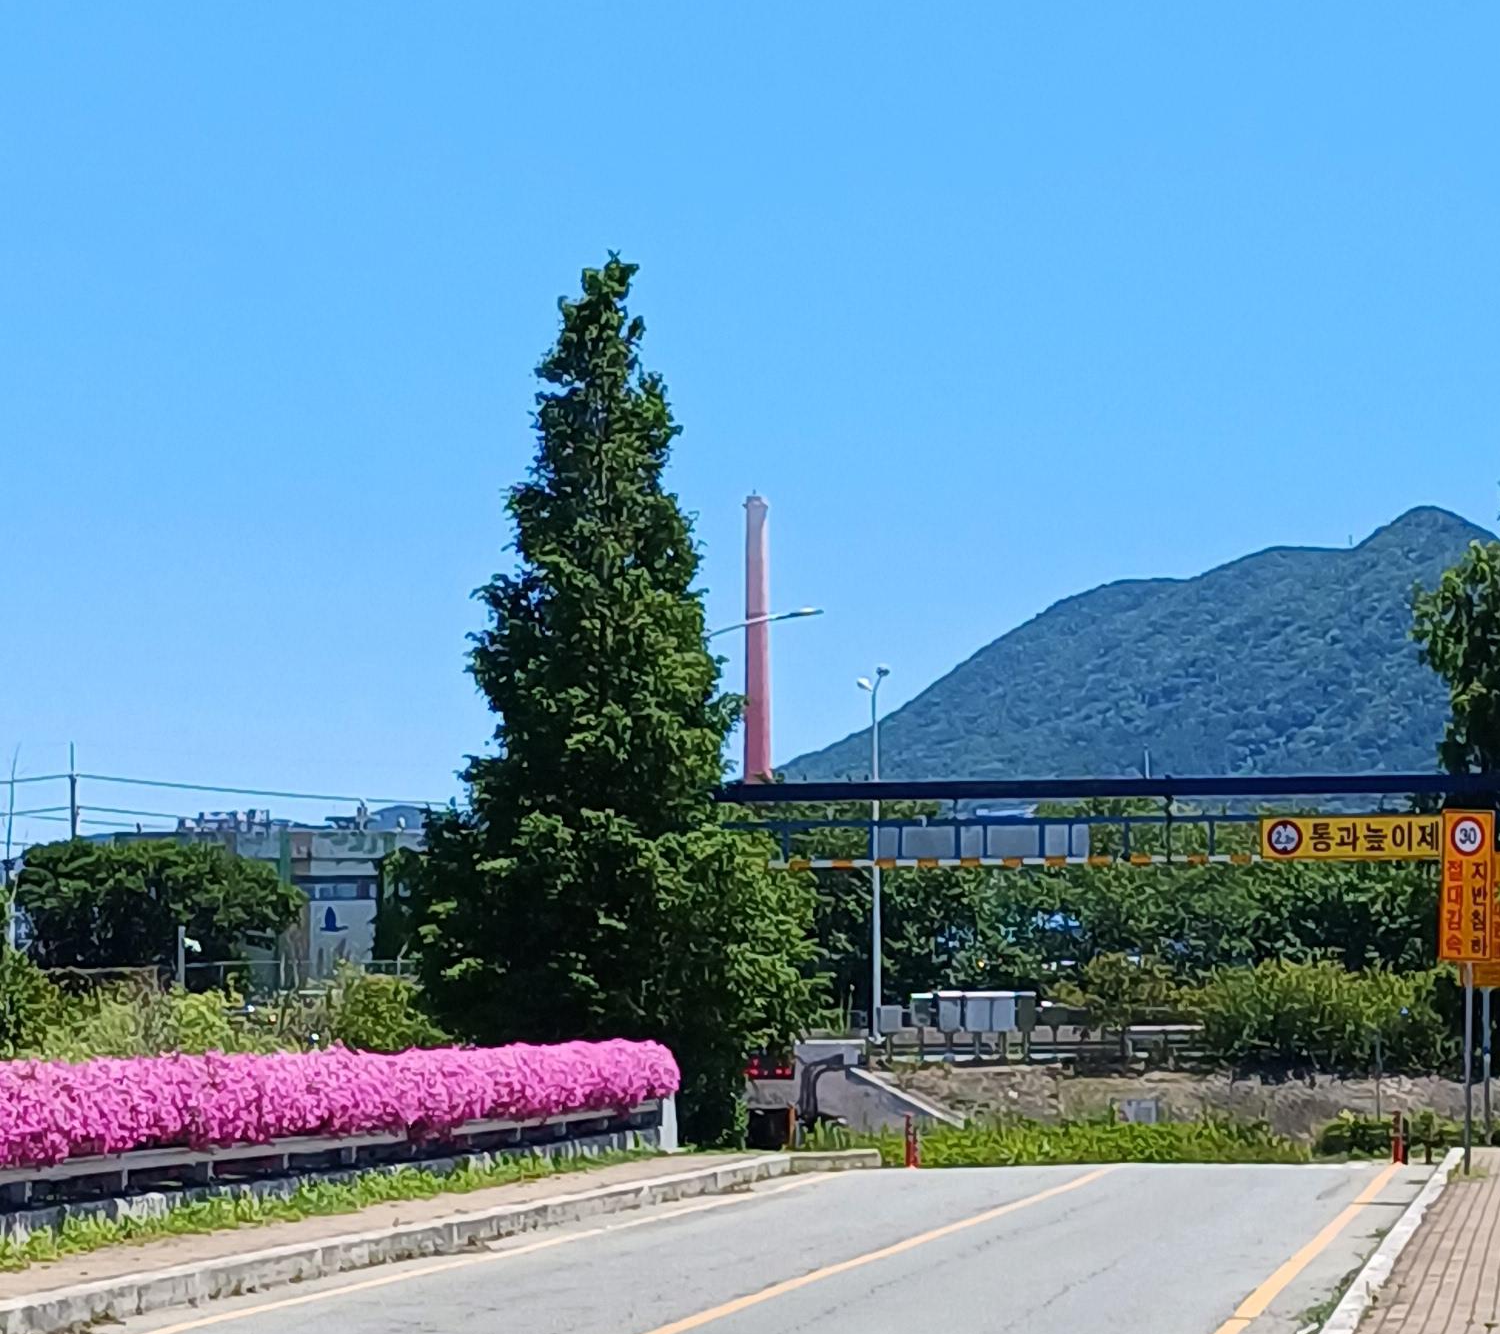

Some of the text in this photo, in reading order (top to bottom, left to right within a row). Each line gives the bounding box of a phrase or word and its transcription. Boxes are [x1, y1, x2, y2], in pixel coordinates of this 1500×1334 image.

[1459, 827, 1477, 845] 30
[1446, 860, 1463, 956] 절대감속
[1471, 860, 1487, 957] 지반침하
